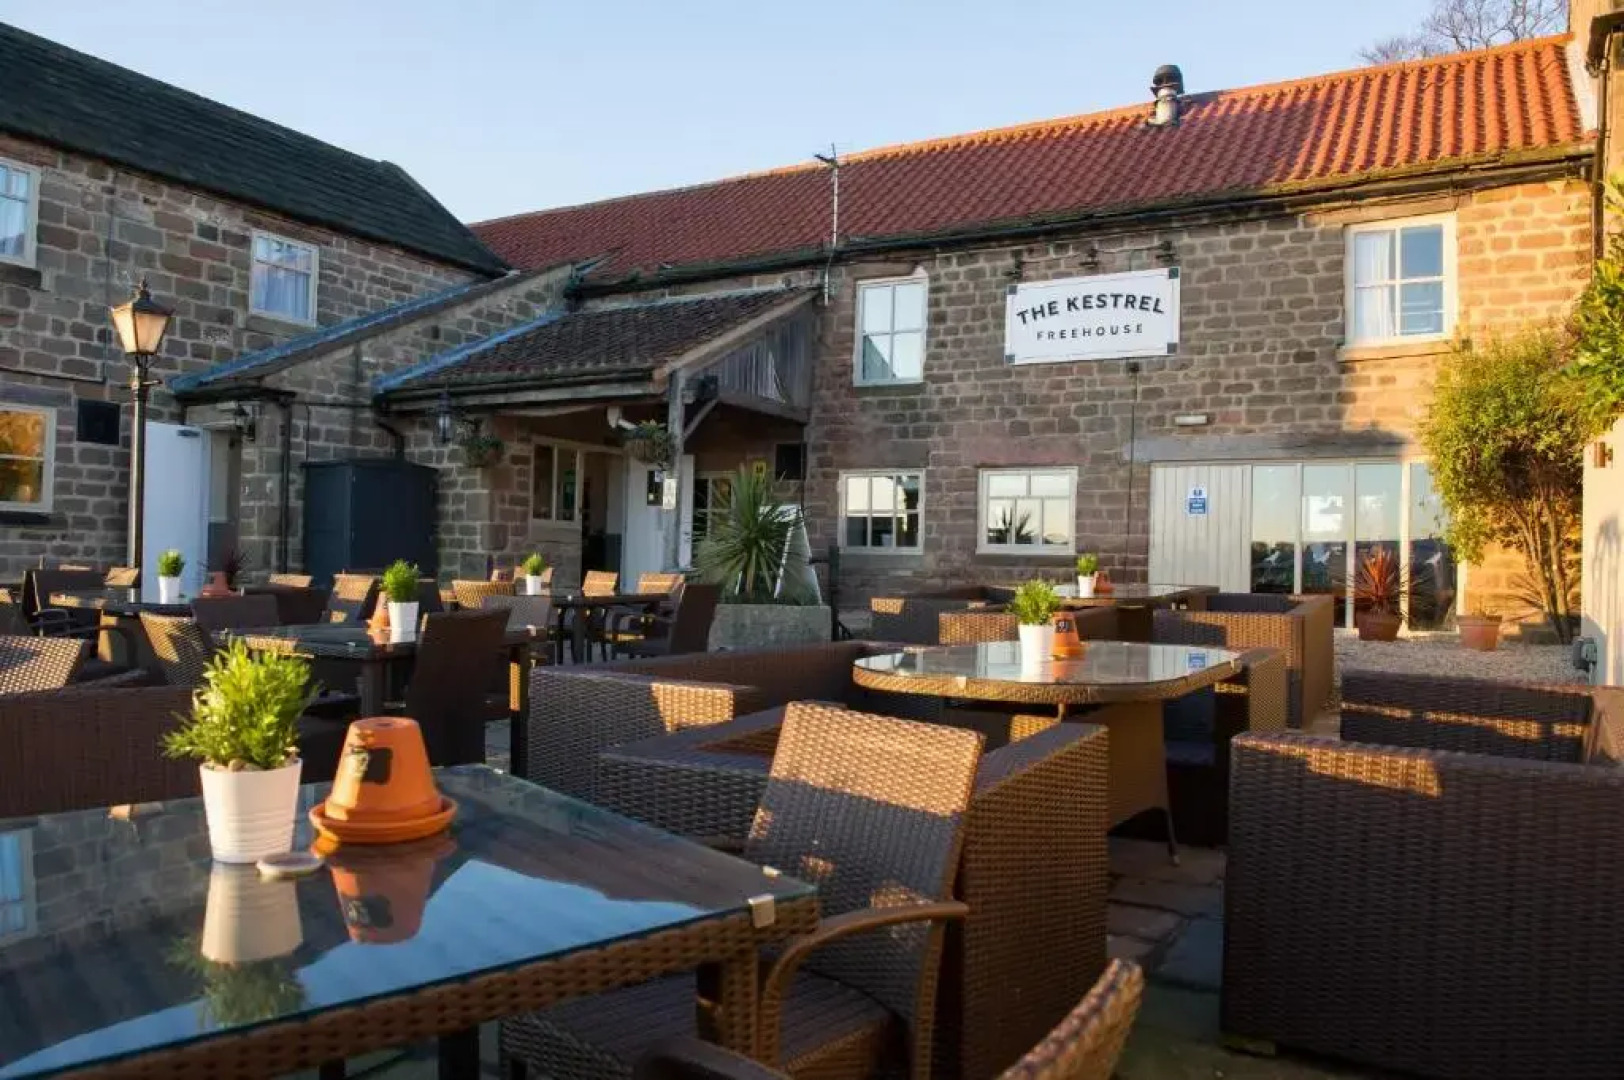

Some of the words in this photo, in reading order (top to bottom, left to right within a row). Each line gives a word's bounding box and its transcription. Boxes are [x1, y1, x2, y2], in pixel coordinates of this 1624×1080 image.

[1016, 301, 1060, 325] THE
[1066, 293, 1165, 314] KESTREL
[1036, 323, 1143, 341] FREEHOUSE
